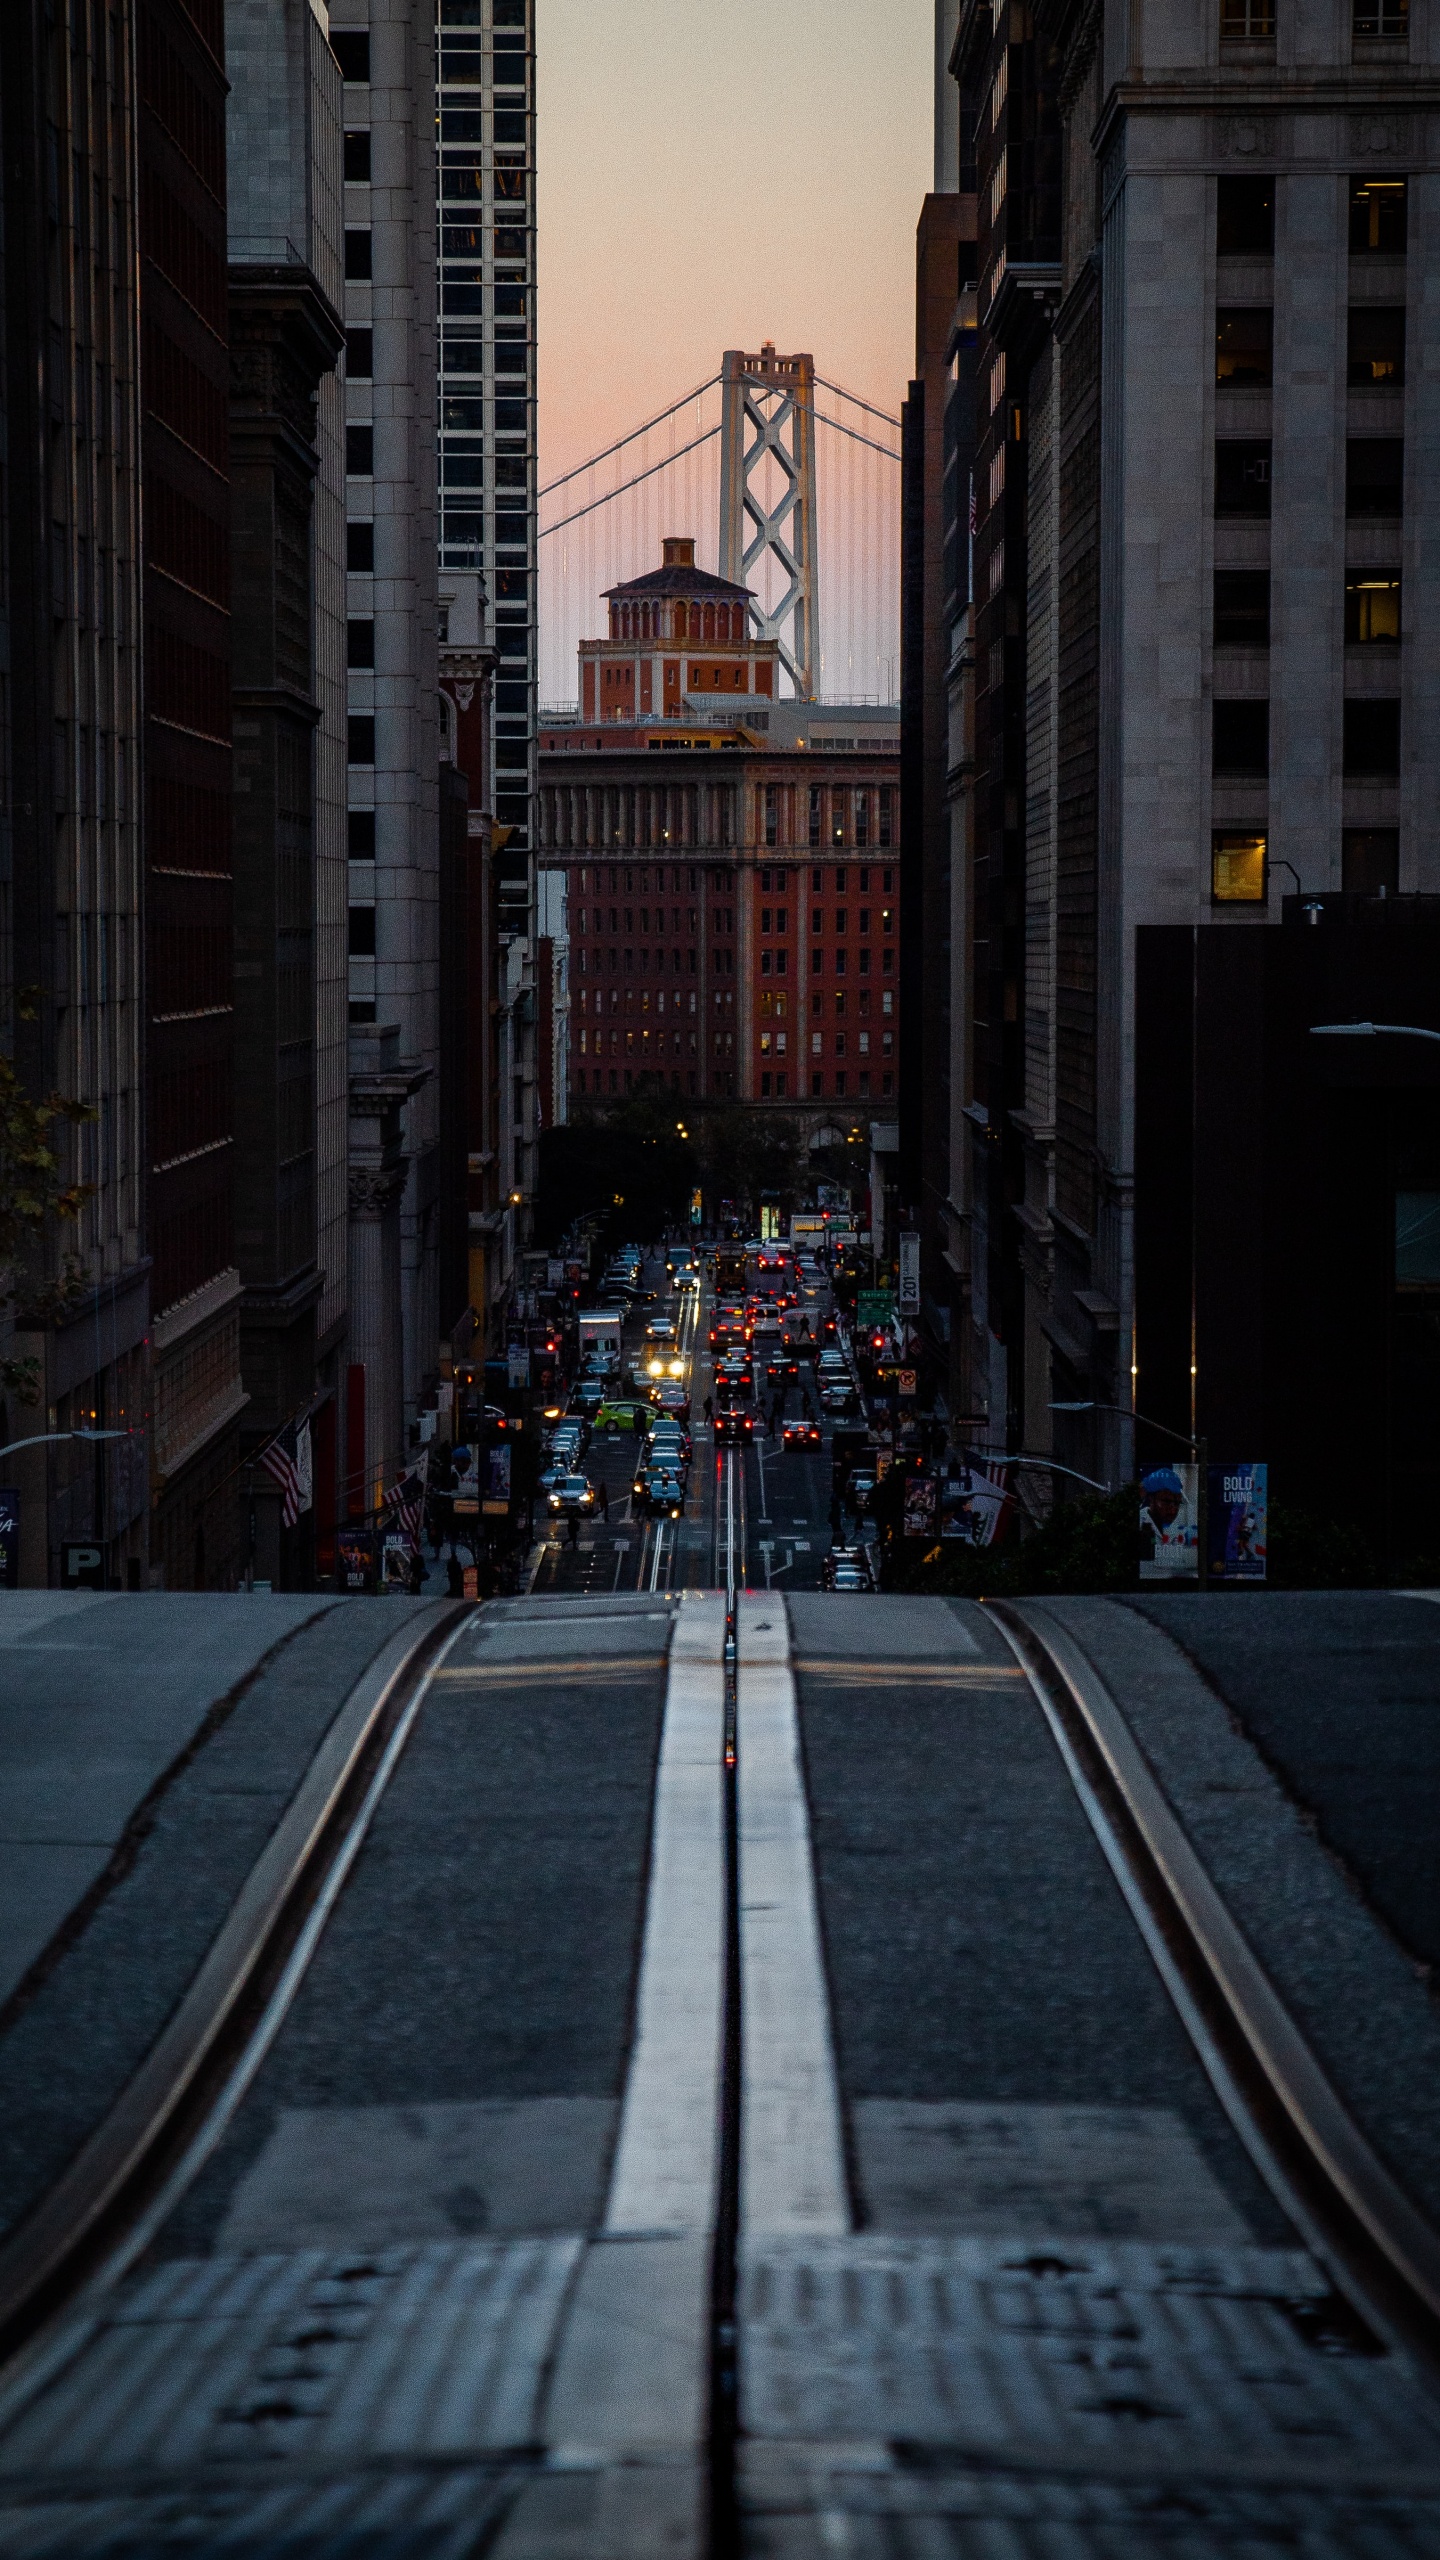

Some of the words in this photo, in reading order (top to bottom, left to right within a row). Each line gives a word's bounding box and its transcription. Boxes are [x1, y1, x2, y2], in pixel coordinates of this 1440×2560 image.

[903, 1276, 917, 1299] 201
[862, 1292, 888, 1300] Battery
[949, 1482, 965, 1490] BOLD
[1223, 1476, 1253, 1491] BOLD
[1223, 1491, 1253, 1503] LIVING
[386, 1535, 403, 1544] BOLD
[67, 1548, 101, 1576] P
[347, 1572, 364, 1581] BOLD
